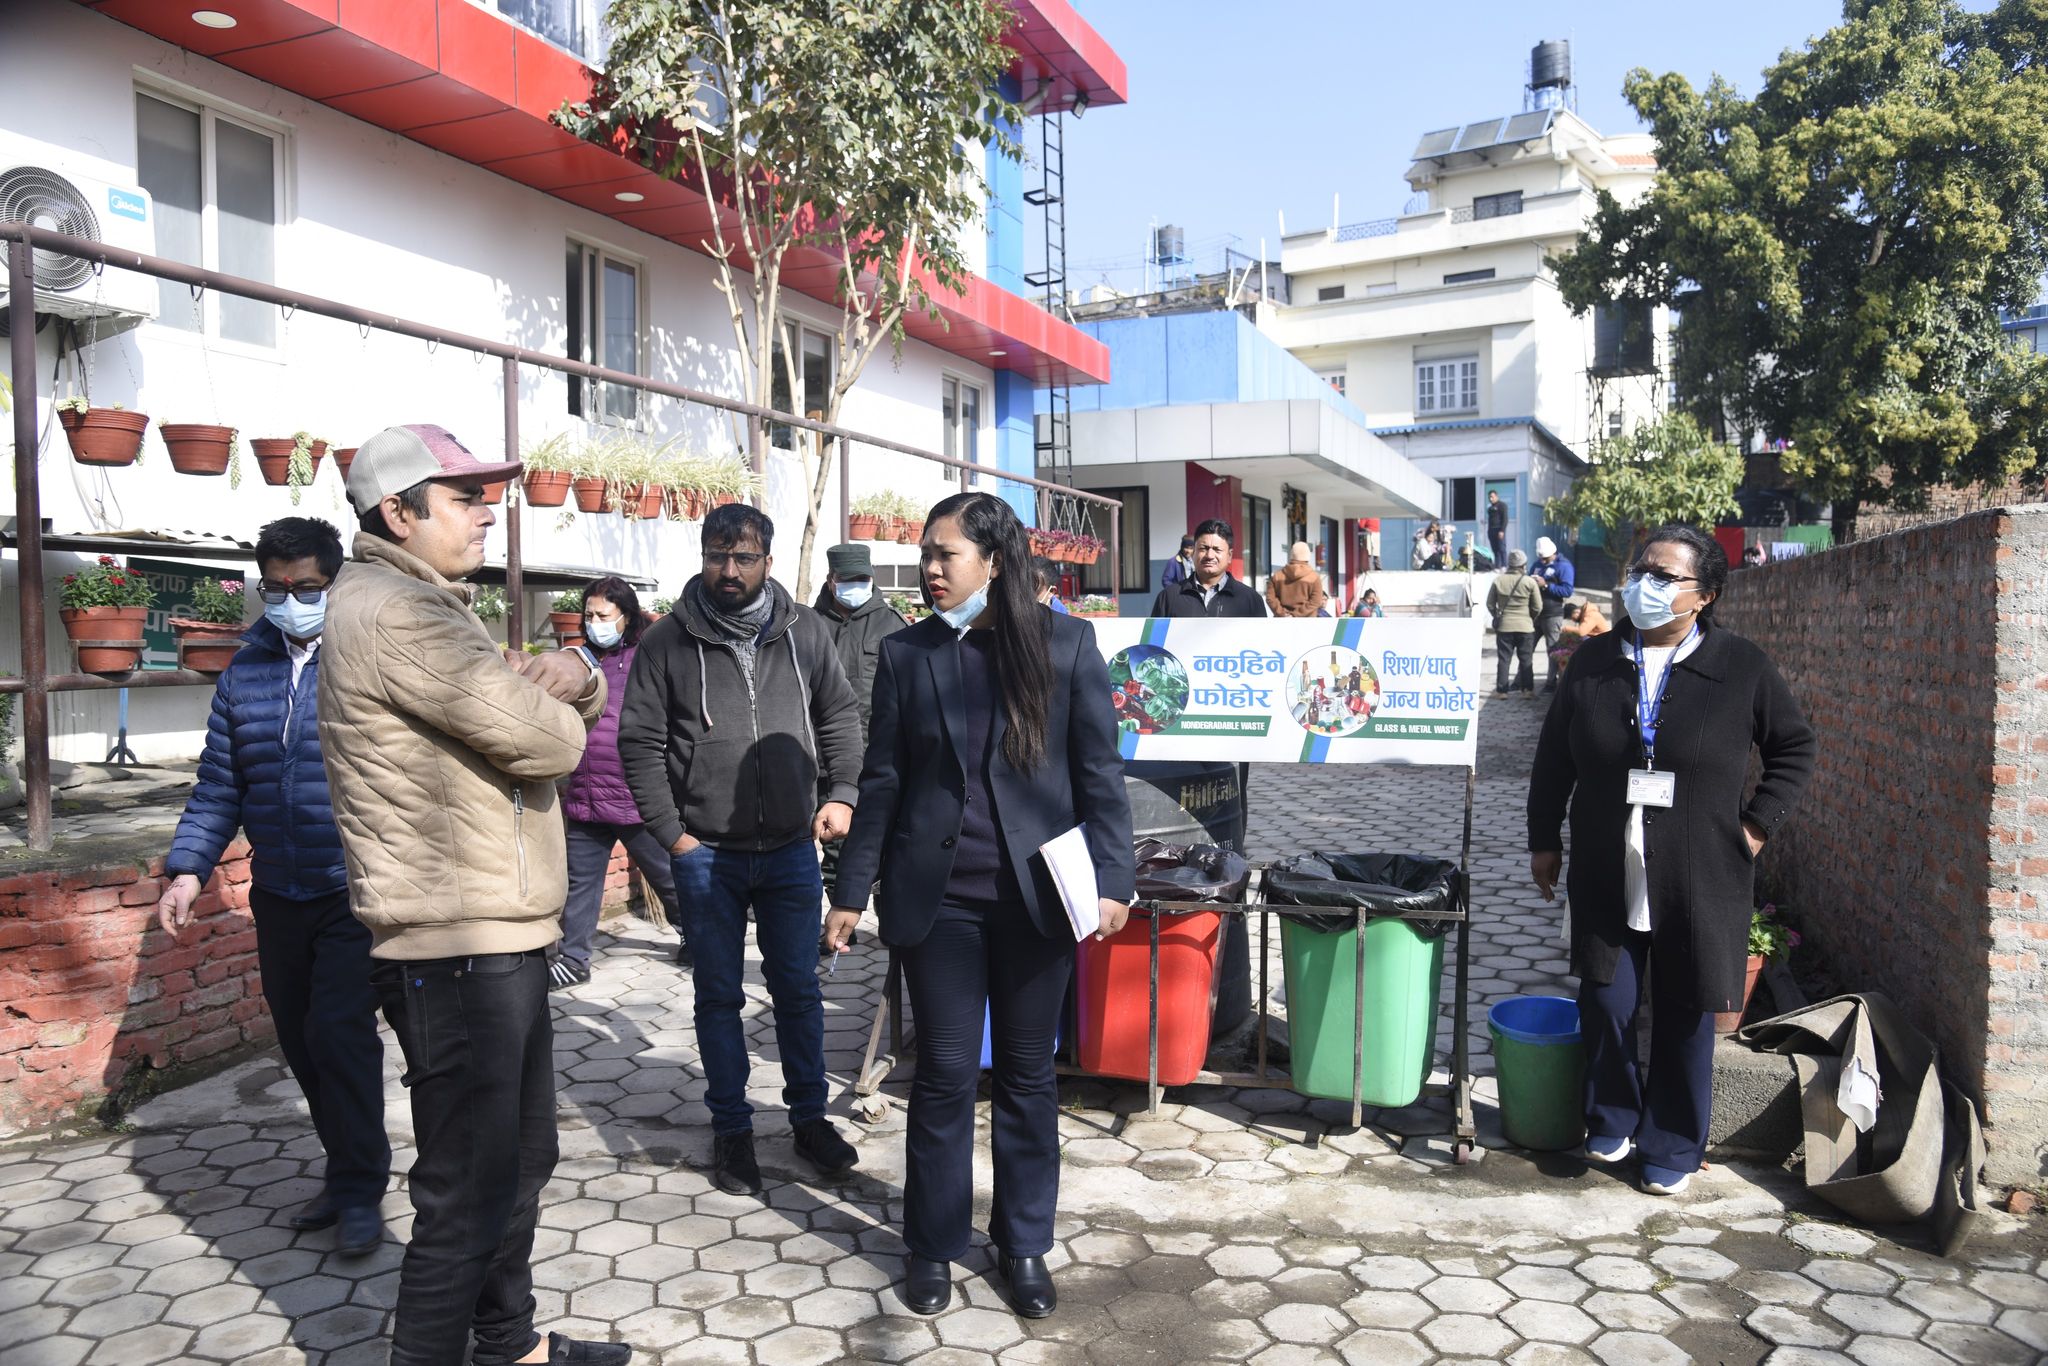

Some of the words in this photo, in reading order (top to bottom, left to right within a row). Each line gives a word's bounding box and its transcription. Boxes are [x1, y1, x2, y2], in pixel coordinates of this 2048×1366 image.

[1193, 649, 1287, 679] नकुहिने
[1383, 650, 1458, 682] शिशा/धातु
[1193, 683, 1273, 708] फोहोर
[1383, 690, 1420, 709] जन्य
[1426, 686, 1477, 712] फोहोर
[1181, 720, 1240, 730] NONDEGRADABLE
[1241, 721, 1266, 731] WASTE
[1374, 723, 1399, 733] GLASS
[1400, 724, 1407, 733] &
[1408, 724, 1432, 734] METAL
[1433, 725, 1460, 735] WASTE
